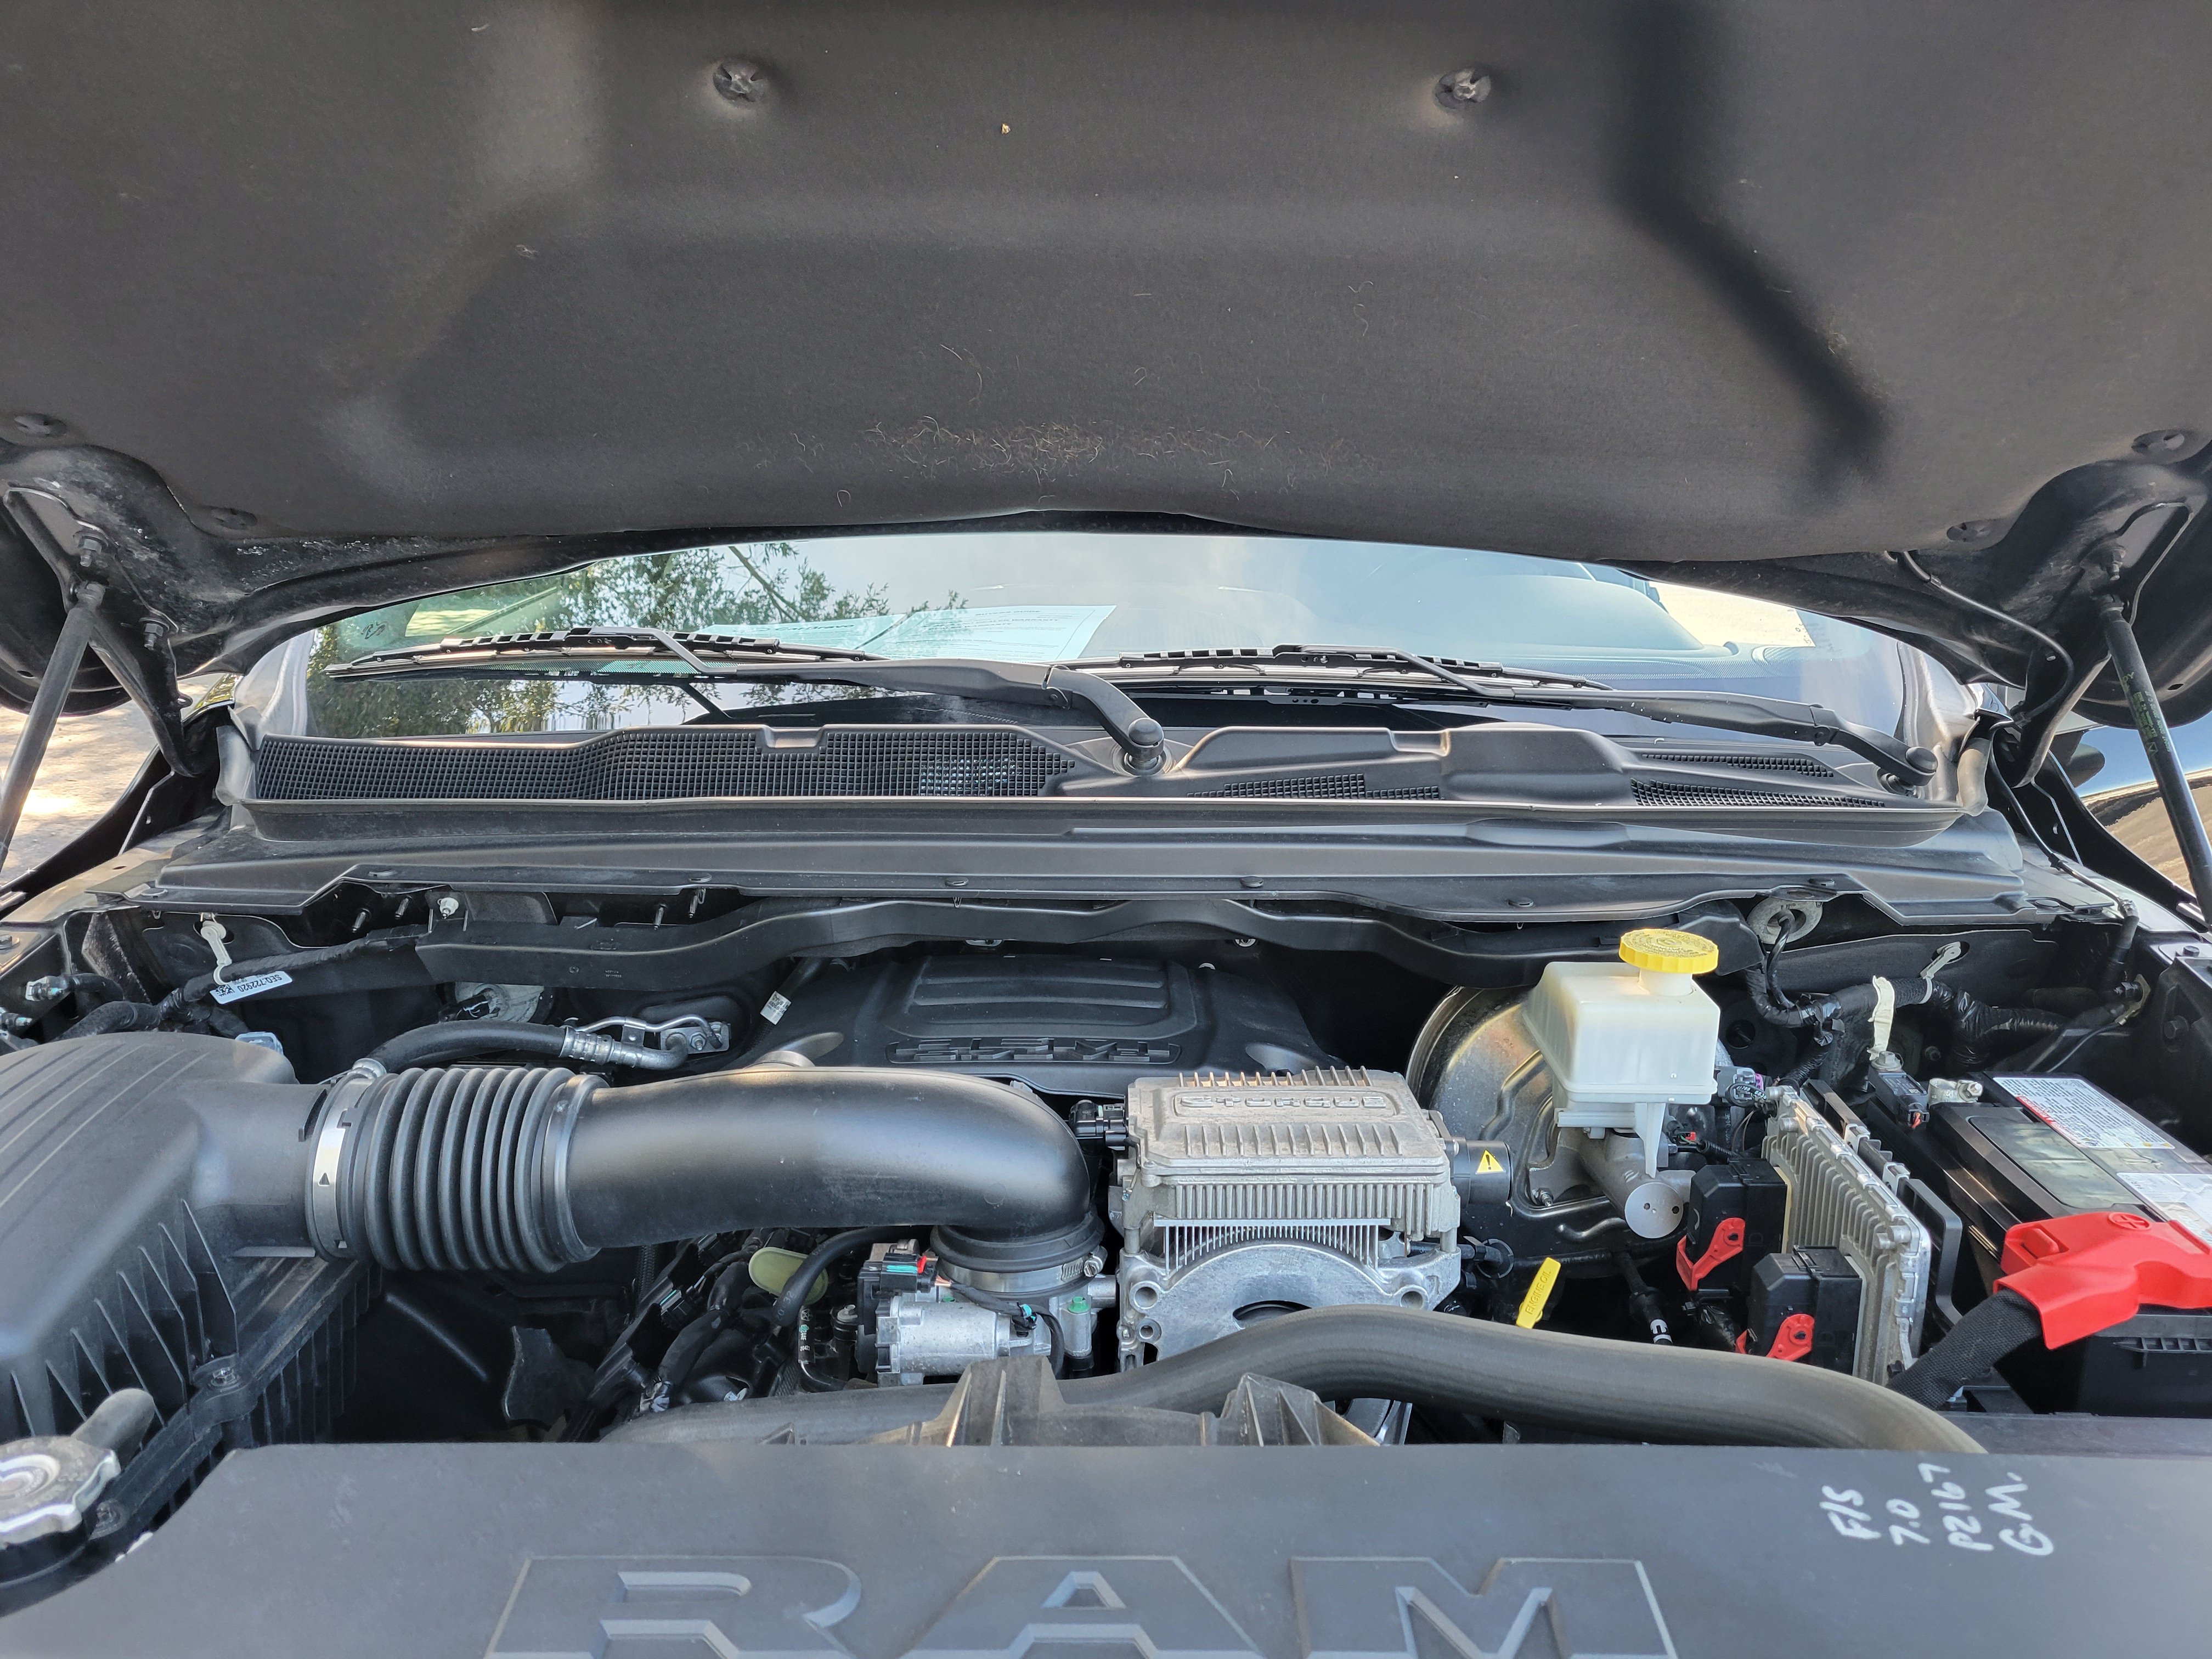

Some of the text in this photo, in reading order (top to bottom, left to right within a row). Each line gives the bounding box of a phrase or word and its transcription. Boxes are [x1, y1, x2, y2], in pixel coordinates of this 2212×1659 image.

[1525, 1271, 1551, 1314] ENGINE OIL
[1885, 1498, 1931, 1545] 7.0
[485, 1554, 1677, 1658] RAM
